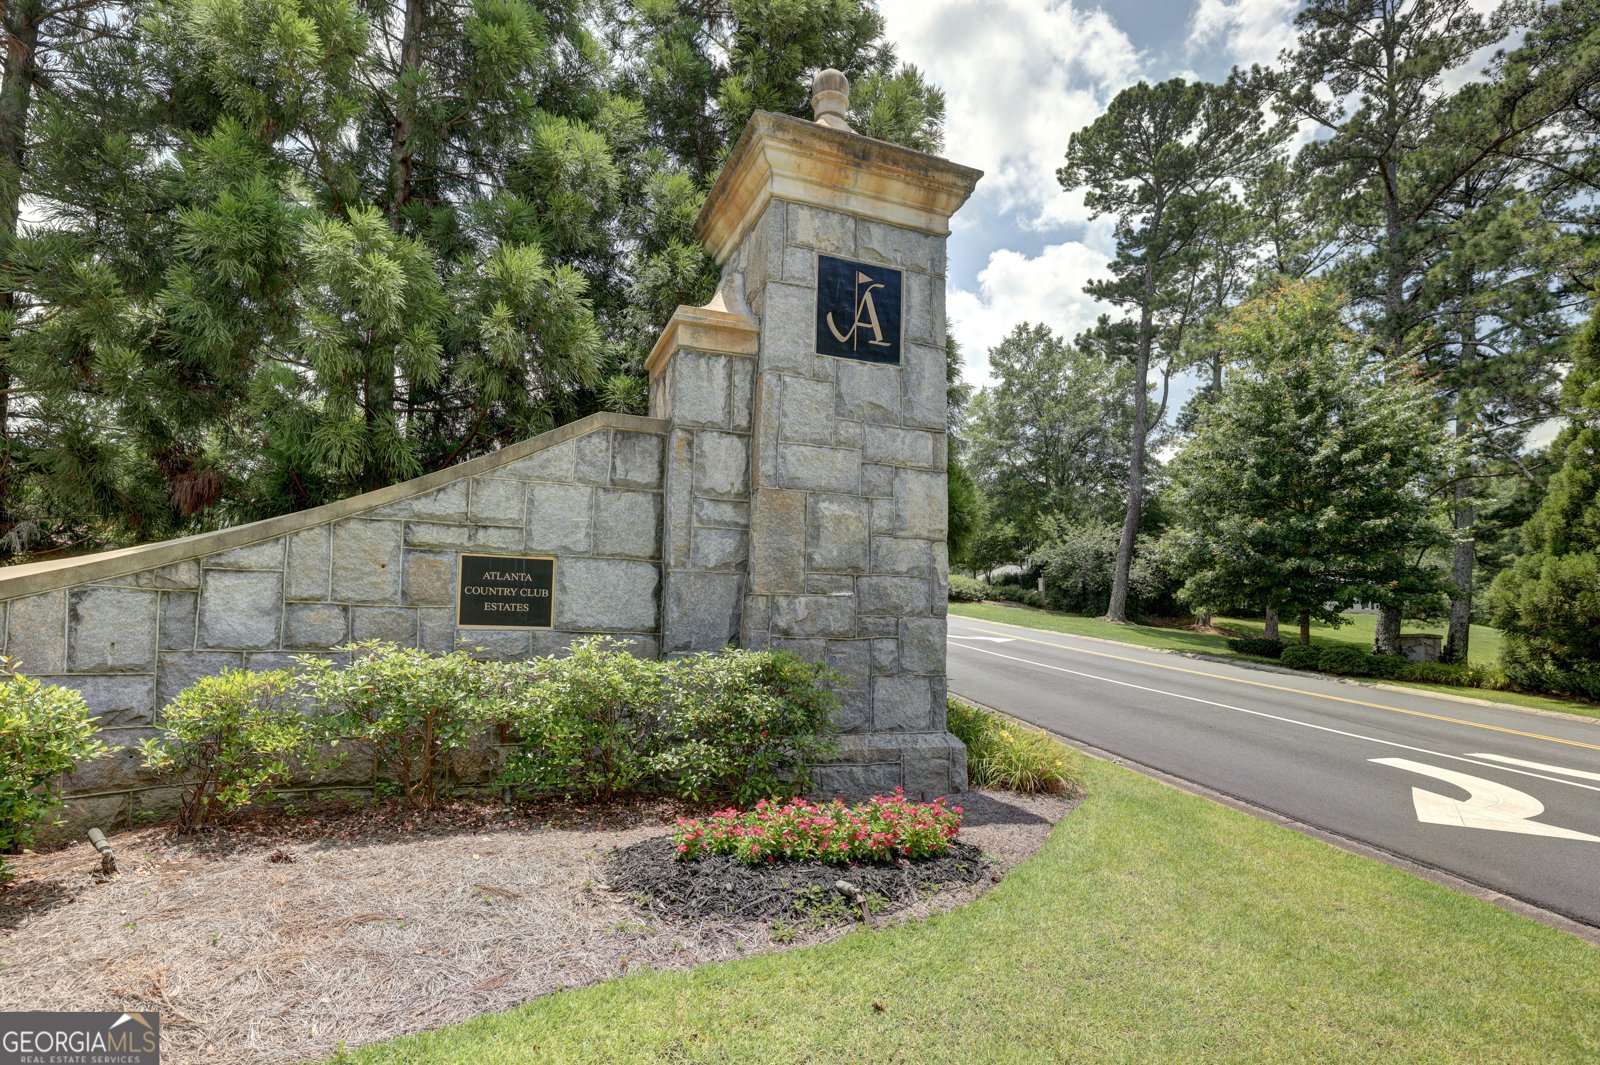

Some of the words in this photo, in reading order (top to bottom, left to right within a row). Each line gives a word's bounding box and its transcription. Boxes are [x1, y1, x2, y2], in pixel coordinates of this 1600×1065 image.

[482, 571, 533, 582] ATLANTA
[464, 586, 518, 597] COUNTRY
[519, 588, 549, 598] CLUB
[484, 602, 530, 612] ESTATES
